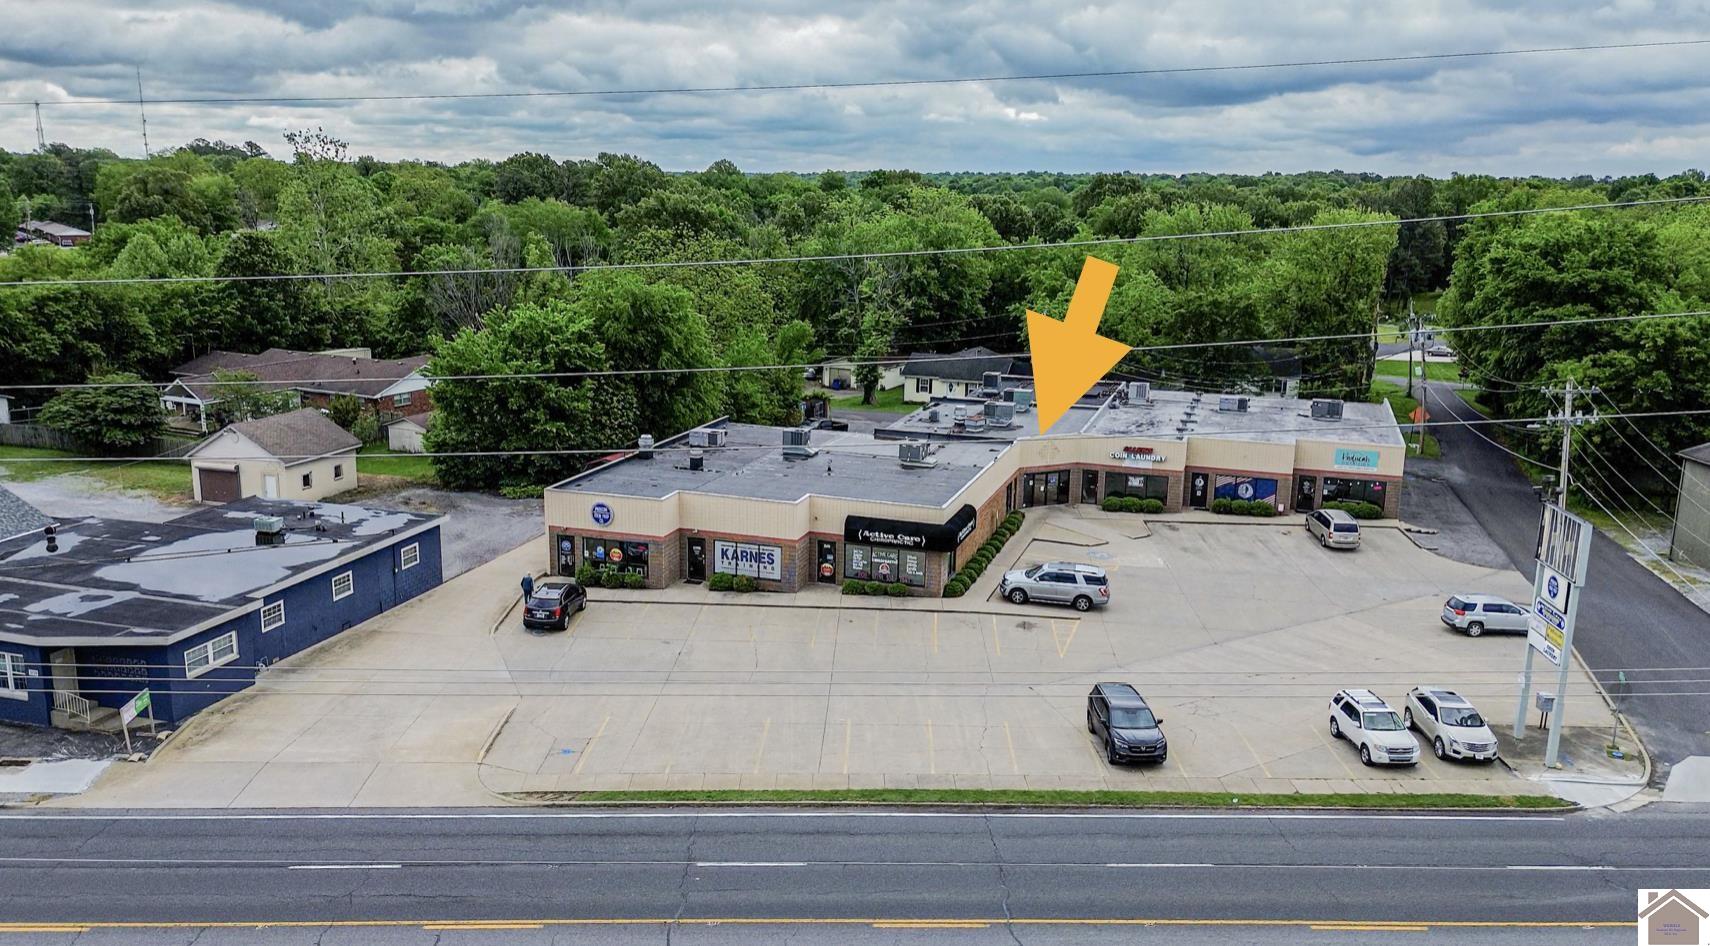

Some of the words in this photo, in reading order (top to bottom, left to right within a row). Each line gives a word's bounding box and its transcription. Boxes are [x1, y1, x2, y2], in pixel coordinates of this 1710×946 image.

[1109, 451, 1128, 460] COIN
[1131, 453, 1167, 462] LAUNDRY
[720, 547, 775, 565] KARNES
[721, 561, 775, 571] TRAINING
